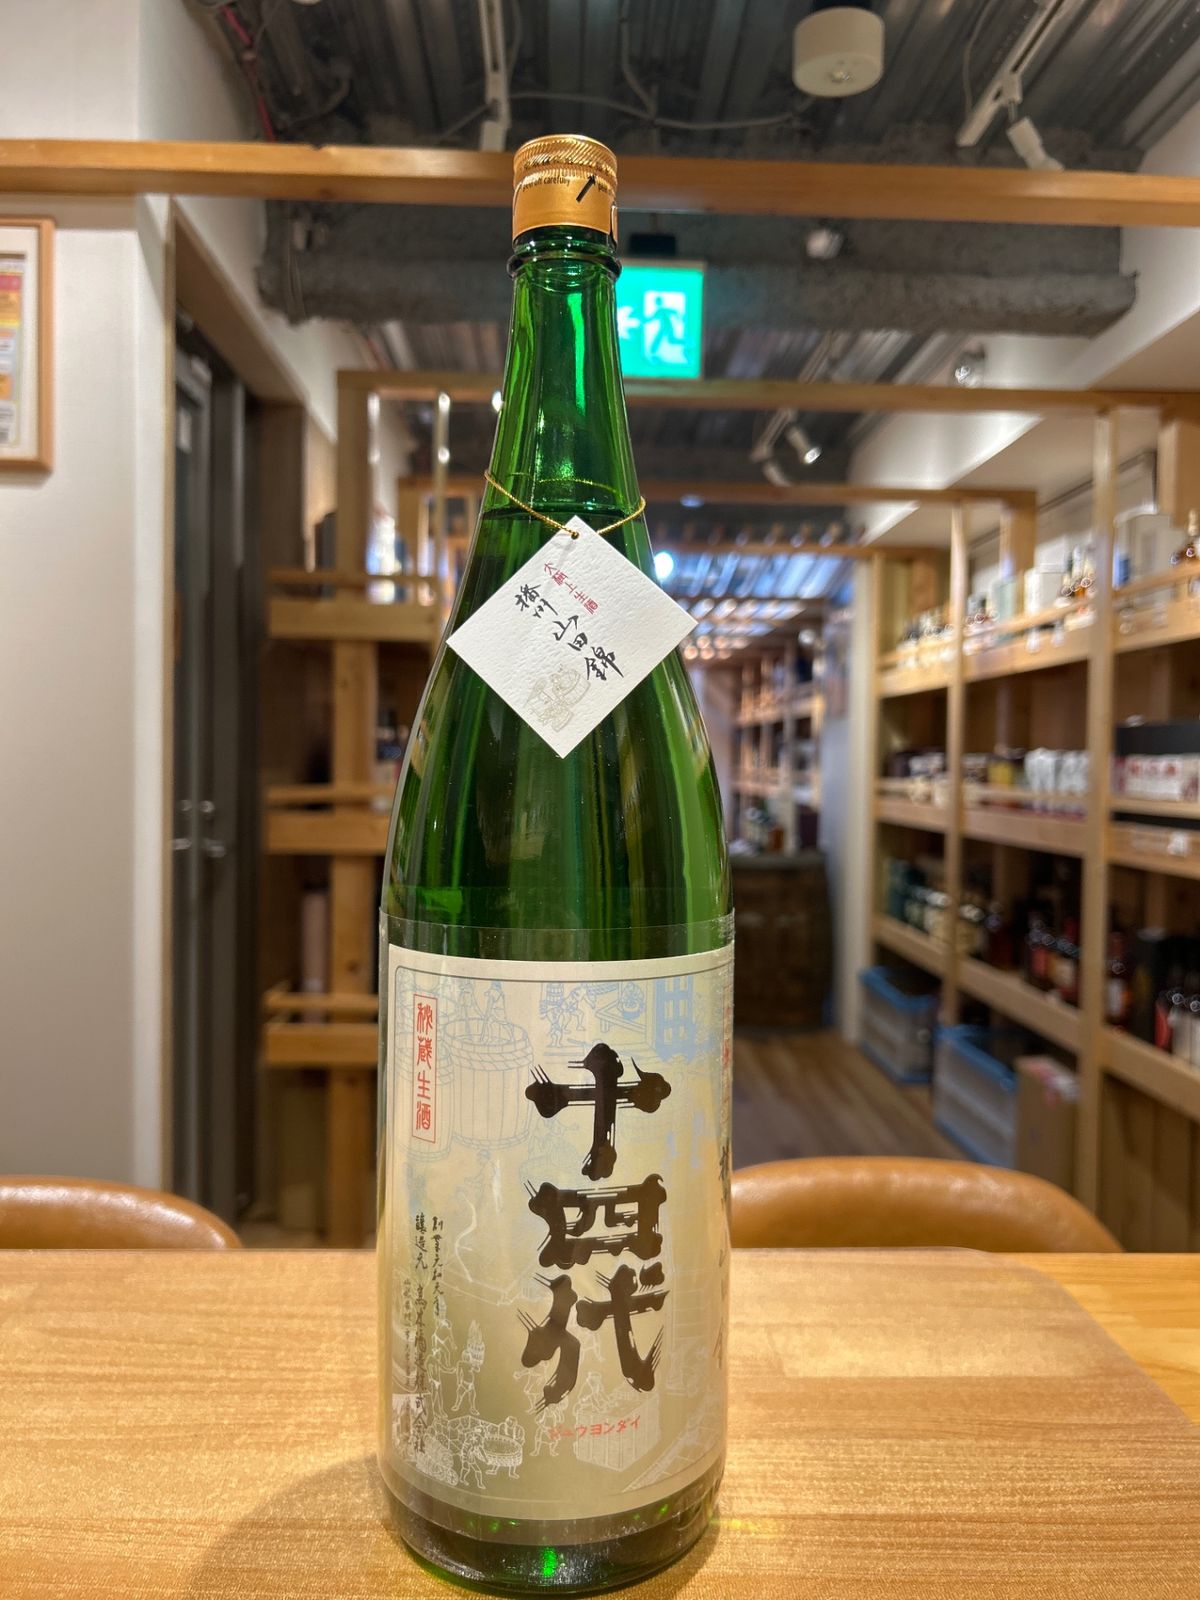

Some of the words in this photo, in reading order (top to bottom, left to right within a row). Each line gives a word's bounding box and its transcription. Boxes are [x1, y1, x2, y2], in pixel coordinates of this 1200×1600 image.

[514, 582, 624, 682] 播州山田錦
[517, 1042, 672, 1414] 十四代
